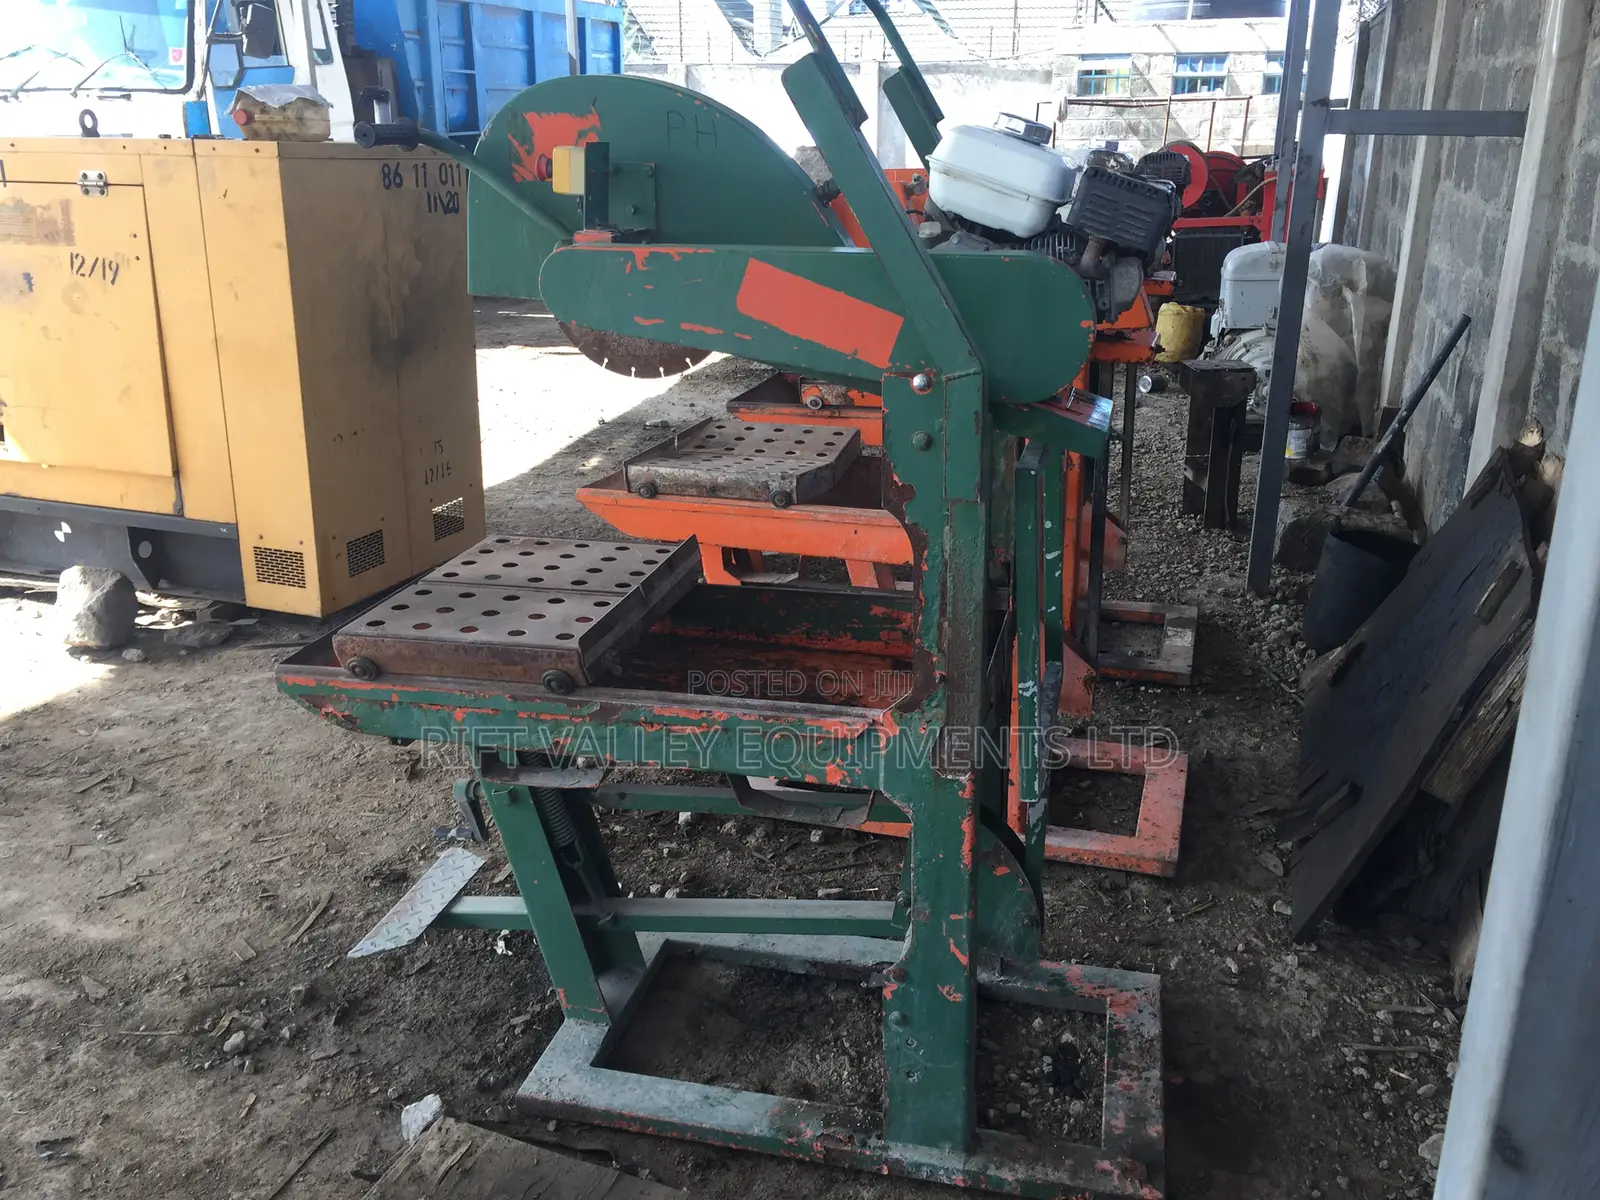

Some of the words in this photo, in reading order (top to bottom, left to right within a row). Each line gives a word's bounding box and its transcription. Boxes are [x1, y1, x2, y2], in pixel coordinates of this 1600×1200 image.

[666, 109, 718, 150] PH
[381, 161, 404, 191] 86
[412, 162, 428, 189] 11
[69, 251, 119, 286] 12/19
